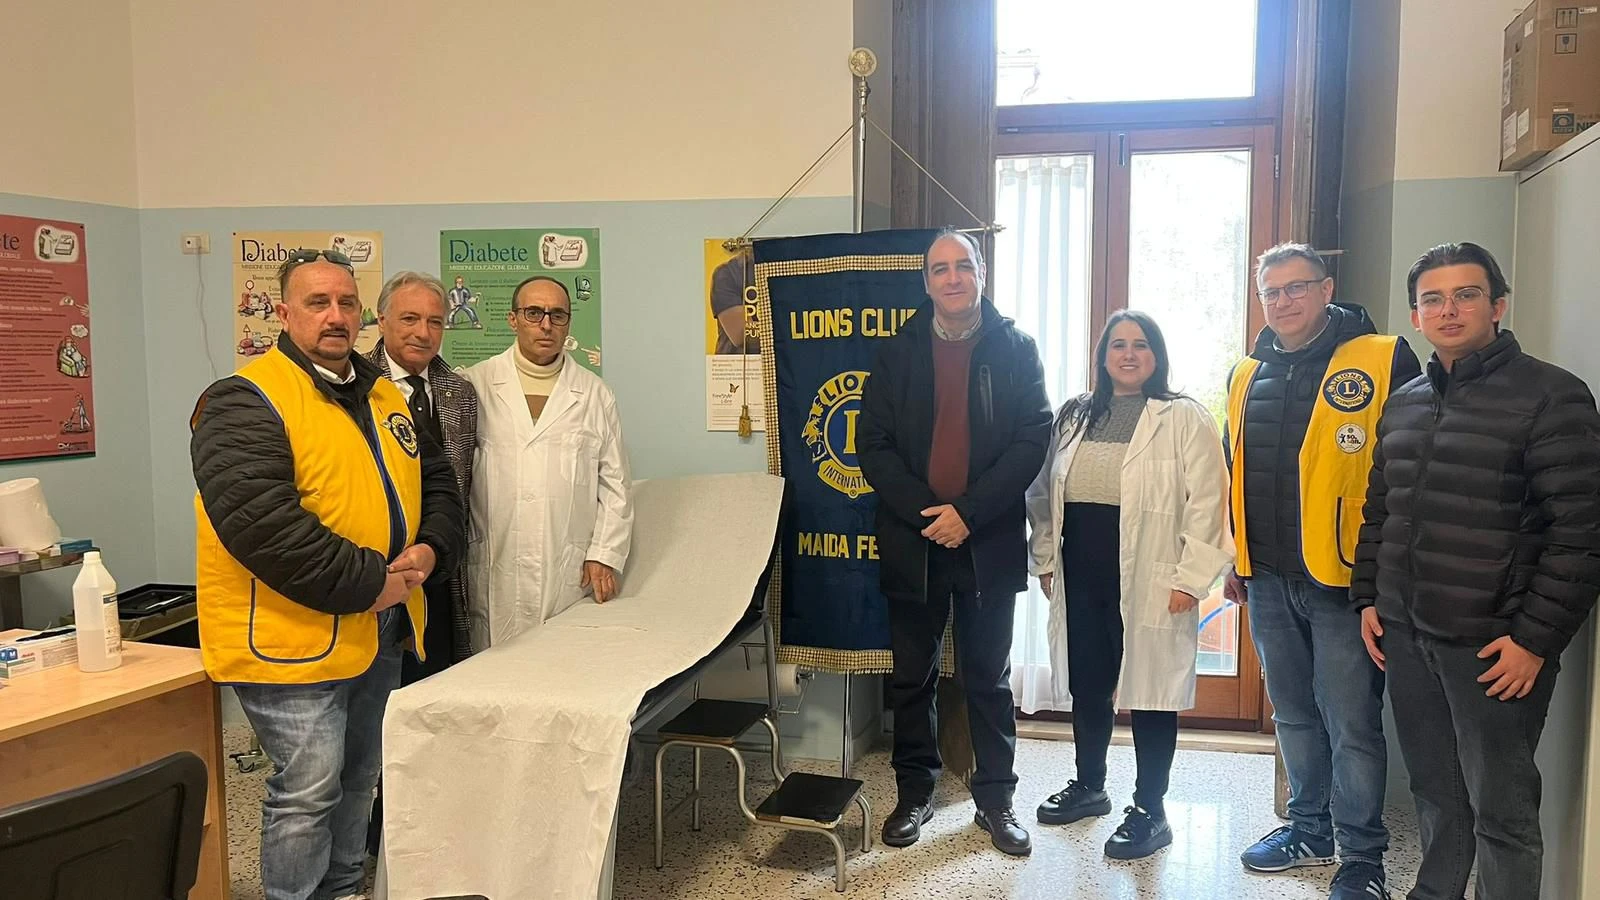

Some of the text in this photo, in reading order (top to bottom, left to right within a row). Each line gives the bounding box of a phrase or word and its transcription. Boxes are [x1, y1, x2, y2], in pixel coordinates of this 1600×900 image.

[0, 233, 20, 250] te
[450, 240, 529, 262] Diabete
[745, 286, 759, 304] O
[790, 308, 918, 339] LIONS CLU
[1336, 372, 1362, 381] LIONS
[822, 374, 867, 402] LIO
[1343, 381, 1356, 395] L
[823, 464, 867, 489] INTERNATI
[798, 532, 880, 559] MAIDA FE
